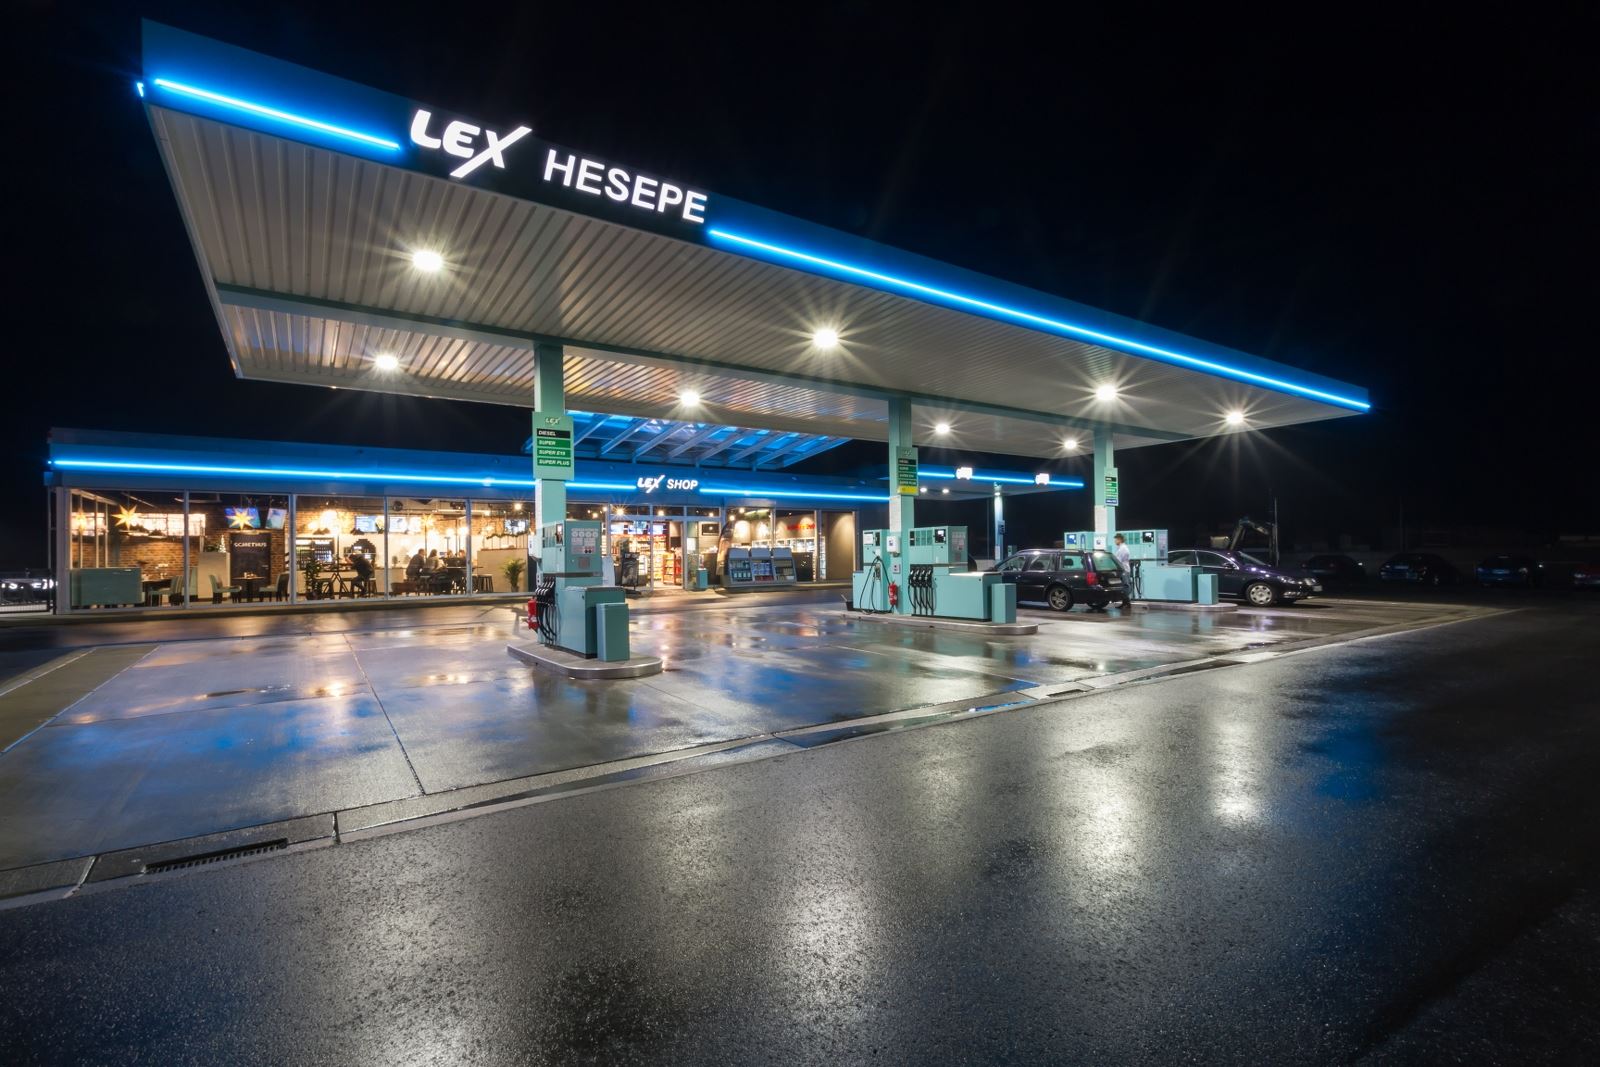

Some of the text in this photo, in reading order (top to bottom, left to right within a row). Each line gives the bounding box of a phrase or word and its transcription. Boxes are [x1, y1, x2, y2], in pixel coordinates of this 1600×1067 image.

[410, 109, 708, 223] LEX HESEPE
[637, 474, 698, 493] LEX SHOP
